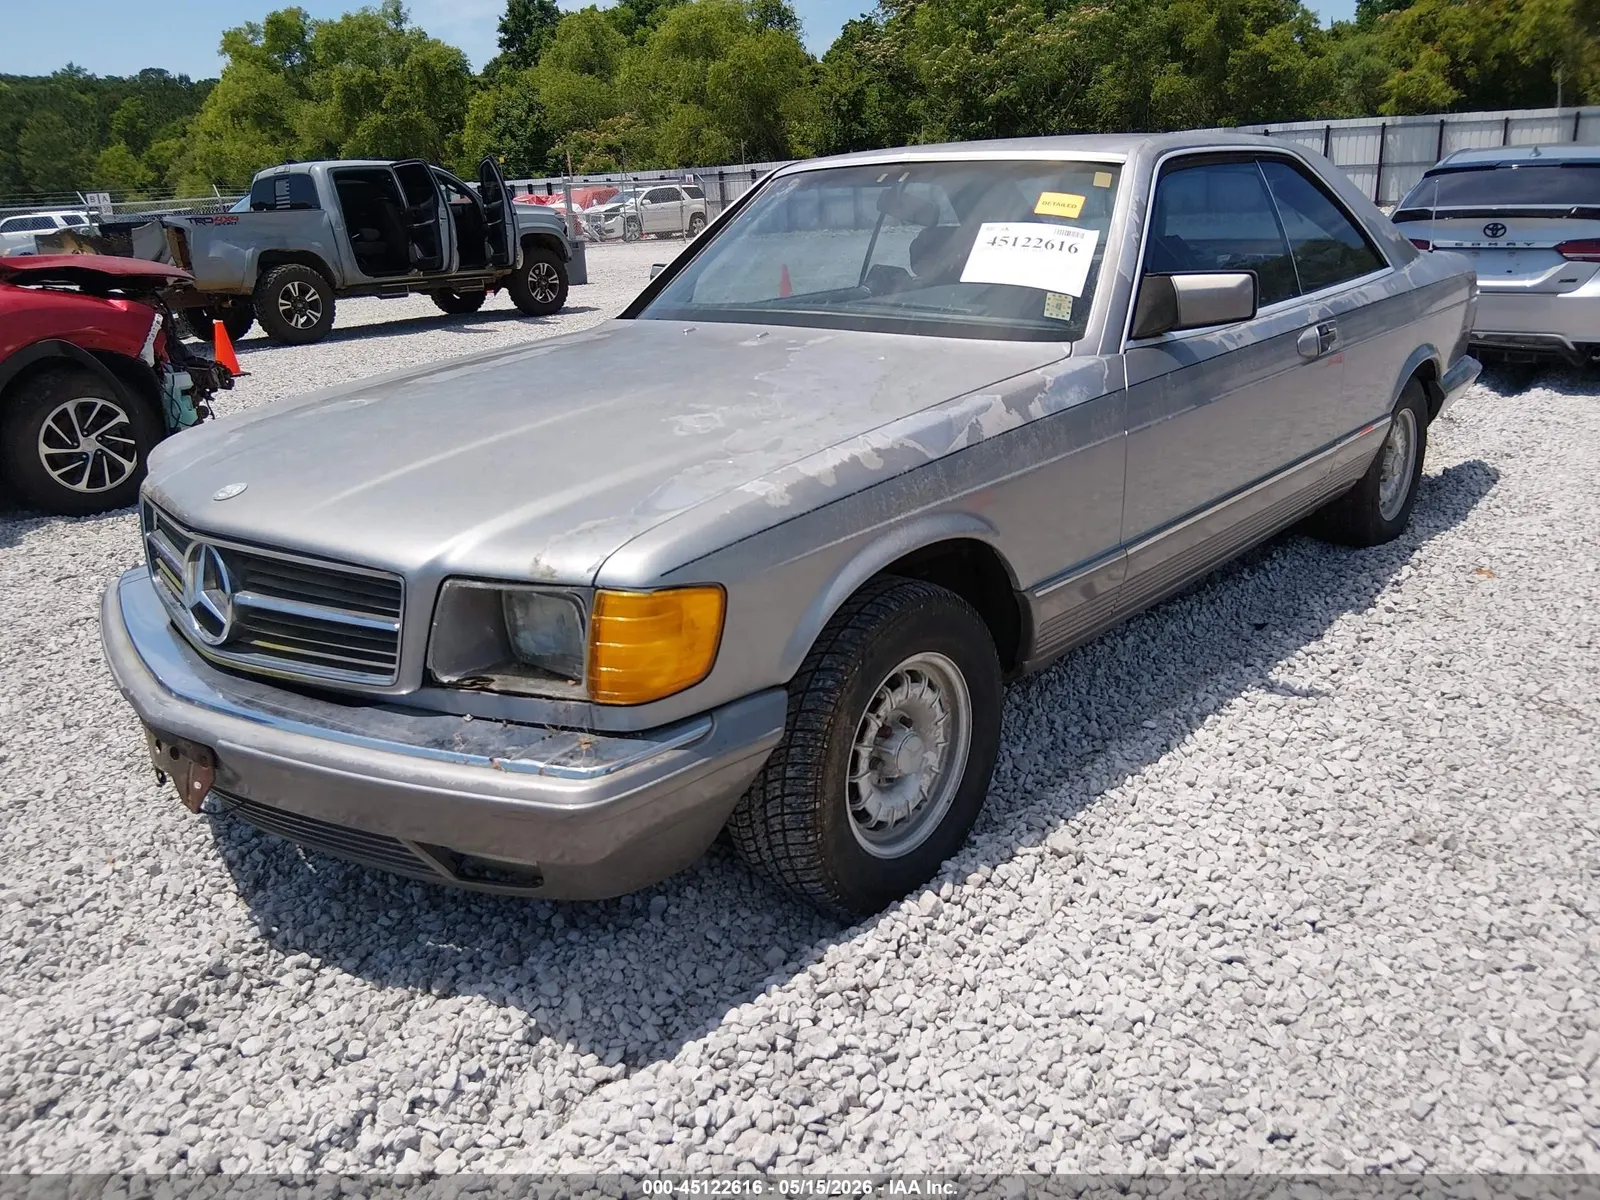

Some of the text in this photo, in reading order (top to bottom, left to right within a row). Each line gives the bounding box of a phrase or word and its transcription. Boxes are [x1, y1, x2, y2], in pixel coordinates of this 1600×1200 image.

[1041, 200, 1076, 209] DETAILED
[185, 217, 213, 227] TRD
[986, 235, 1078, 254] 45122616
